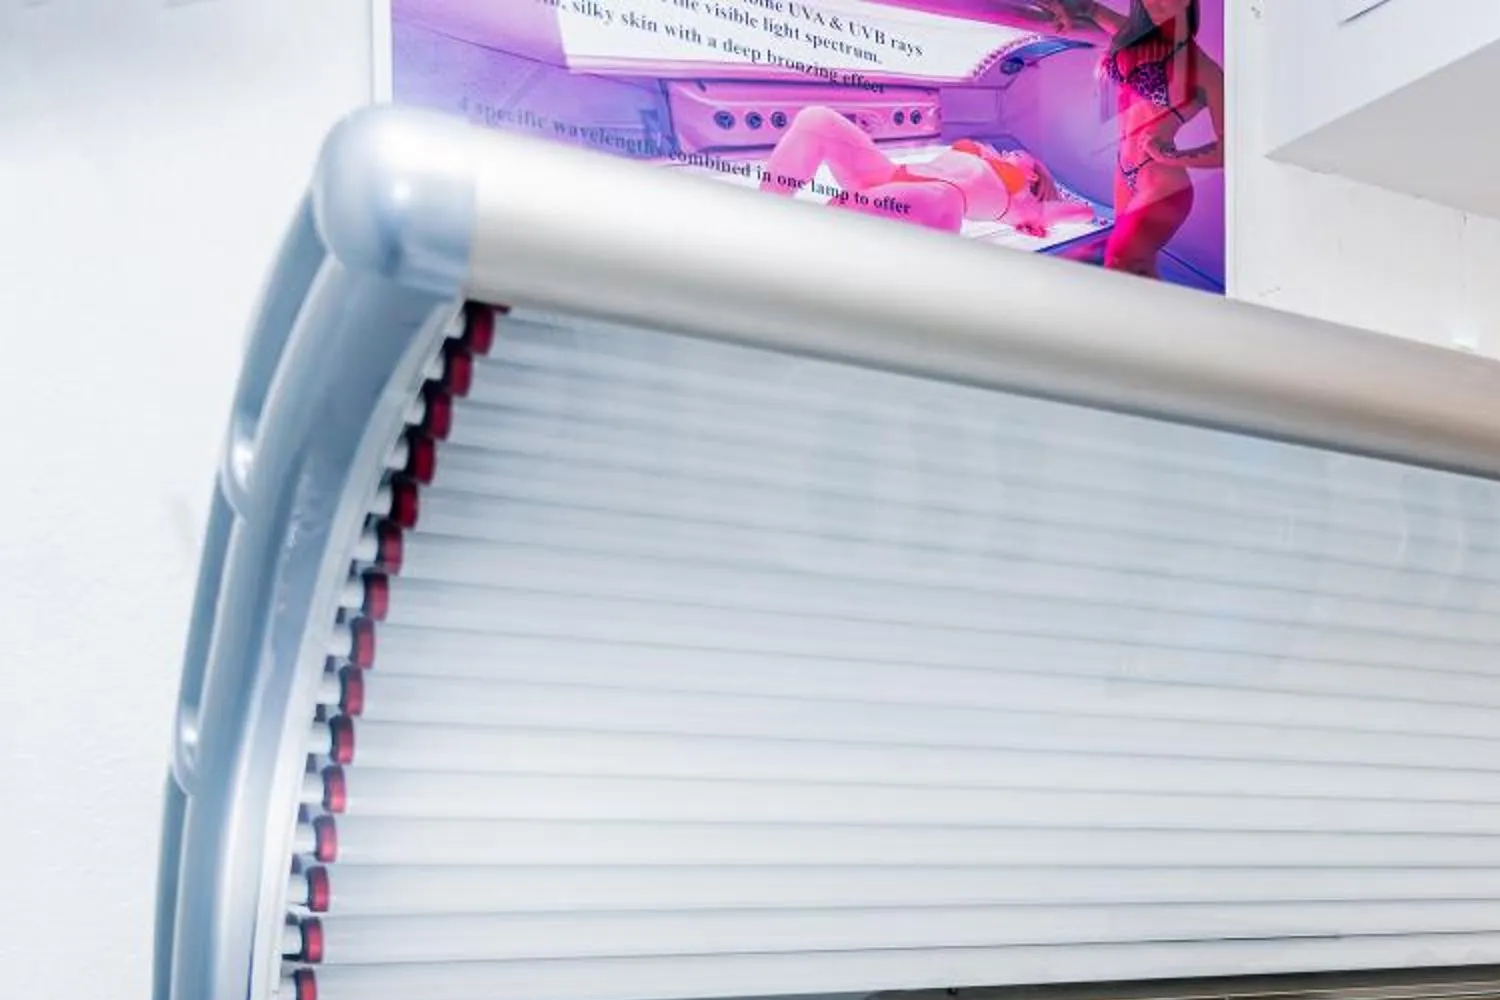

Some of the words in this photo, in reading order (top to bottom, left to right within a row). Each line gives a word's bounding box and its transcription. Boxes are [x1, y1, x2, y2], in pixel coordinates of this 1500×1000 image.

[573, 0, 613, 25] silky
[621, 11, 657, 33] skin
[664, 24, 701, 44] with
[707, 36, 717, 48] a
[723, 38, 761, 63] deep
[767, 51, 837, 84] bronzing
[842, 72, 885, 94] effect
[705, 3, 758, 28] visible
[763, 16, 799, 40] light
[805, 33, 883, 65] spectrum.
[789, 2, 825, 25] UVA
[829, 16, 842, 31] &
[849, 21, 886, 45] UVB
[890, 37, 924, 57] rays
[668, 149, 750, 177] combined
[757, 164, 771, 183] in
[777, 173, 806, 190] one
[811, 179, 849, 204] lamp
[854, 189, 869, 206] to
[873, 195, 912, 215] offer
